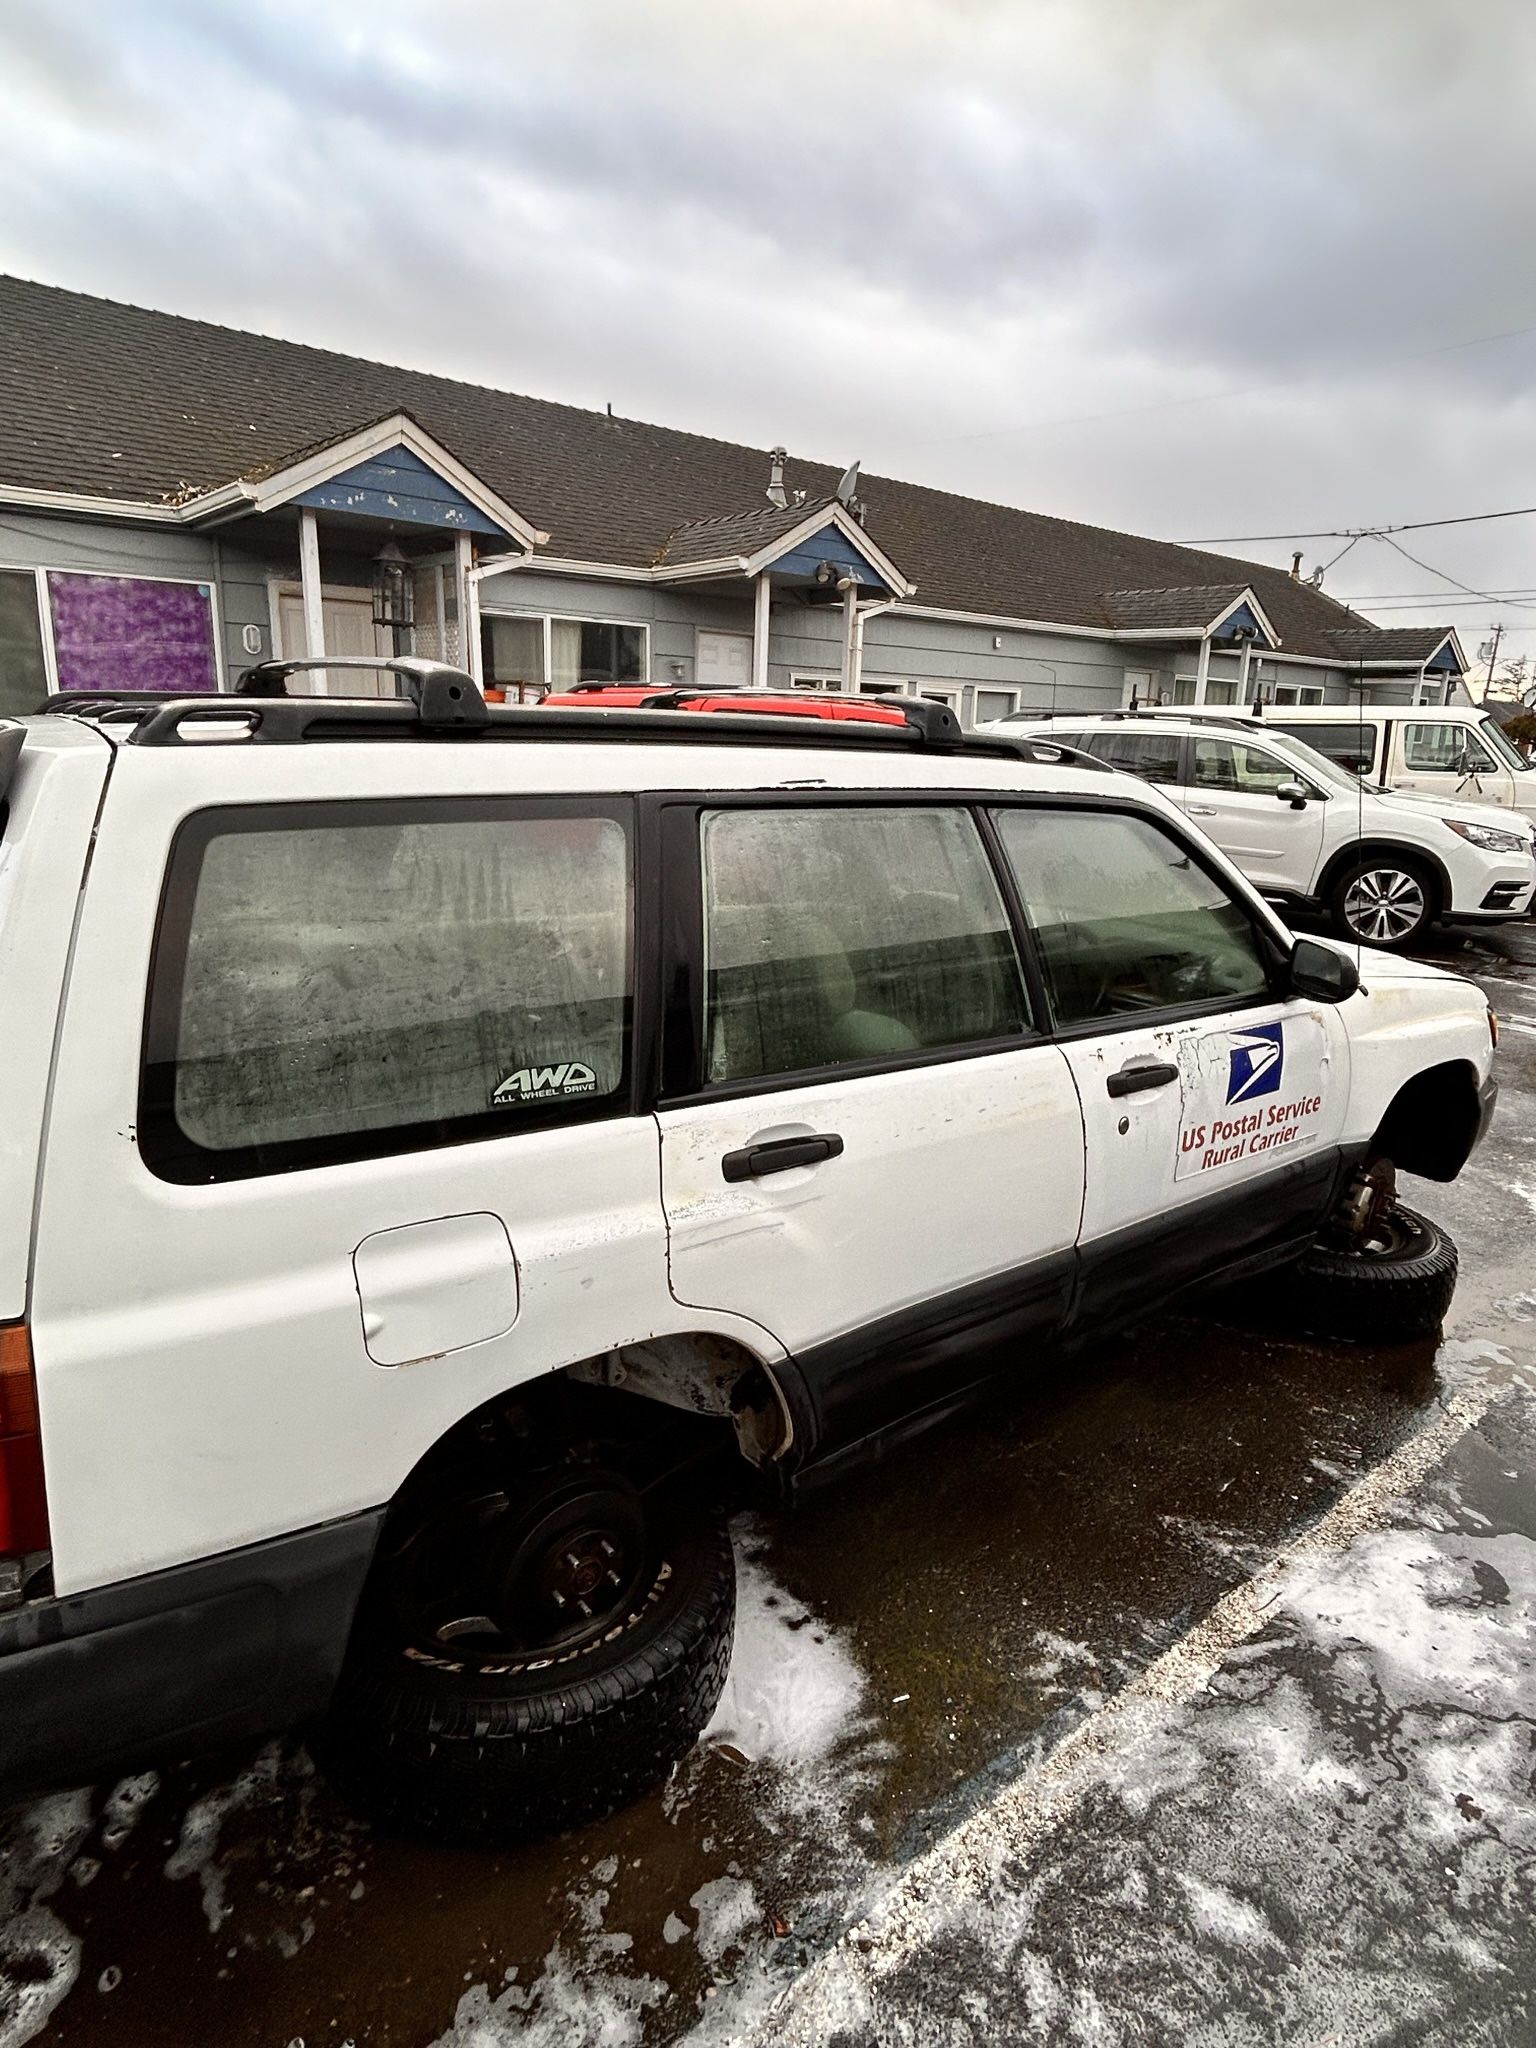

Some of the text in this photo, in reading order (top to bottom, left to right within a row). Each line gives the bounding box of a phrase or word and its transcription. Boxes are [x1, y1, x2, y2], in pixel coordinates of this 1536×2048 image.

[493, 1062, 596, 1096] AWD
[493, 1083, 596, 1104] ALL WHEEL DRIVE
[1182, 1096, 1321, 1152] US Postal Service
[1201, 1126, 1299, 1170] Rural Carrier
